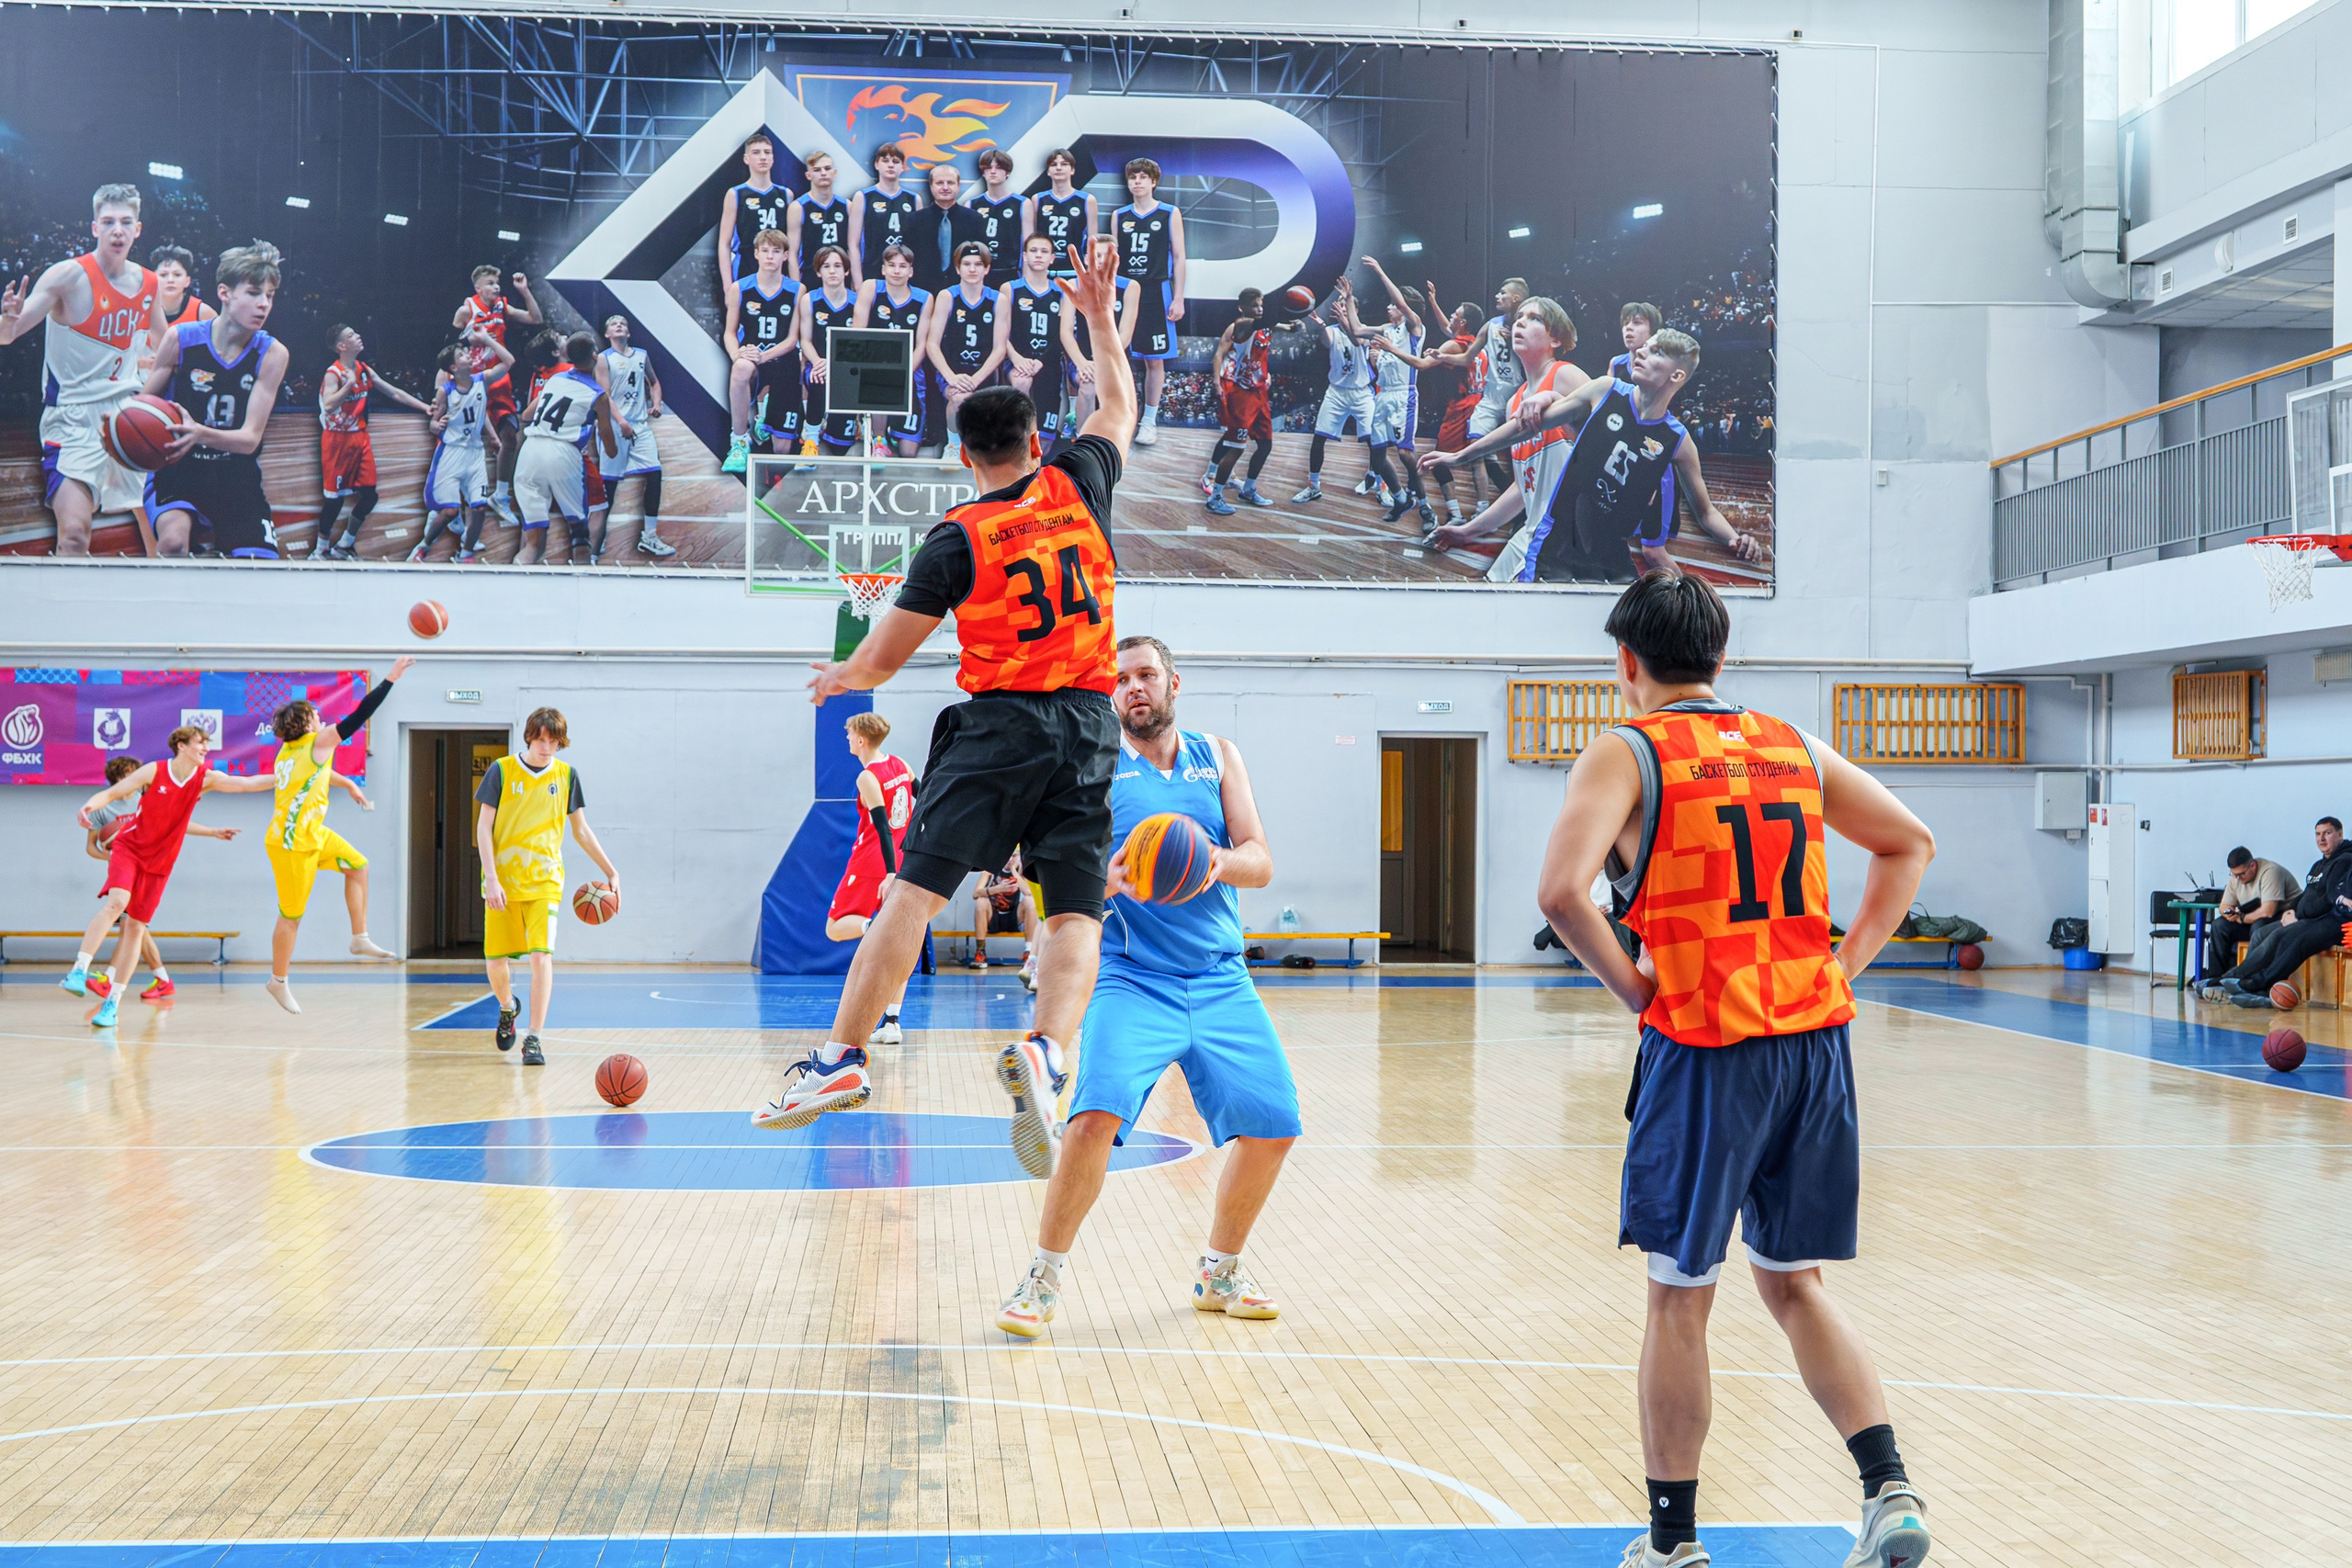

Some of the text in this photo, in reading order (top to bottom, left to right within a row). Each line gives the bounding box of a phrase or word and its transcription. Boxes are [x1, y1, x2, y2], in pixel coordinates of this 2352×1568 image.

[757, 208, 777, 230] 34
[888, 212, 900, 232] 4
[986, 218, 999, 237] 8
[1048, 216, 1069, 236] 22
[821, 222, 838, 244] 23
[1130, 232, 1150, 253] 15
[98, 308, 145, 341] ЦСК
[758, 316, 777, 339] 13
[1030, 311, 1048, 335] 19
[966, 324, 978, 346] 5
[1152, 333, 1166, 351] 15
[108, 356, 123, 380] 2
[628, 370, 637, 387] 4
[783, 412, 798, 429] 13
[903, 413, 918, 432] 11
[1043, 412, 1057, 430] 19
[1237, 428, 1249, 441] 22
[797, 480, 979, 516] АРХСТР
[989, 513, 1075, 546] БАСКЕТБОЛ СТУДЕНТАМ
[1003, 544, 1102, 643] 34
[448, 690, 481, 701] ЫХОД
[1419, 702, 1450, 712] ЫХОД
[1, 752, 42, 764] ФБХК
[1690, 761, 1801, 781] БАСКЕТБОЛ СТУДЕНТАМ
[511, 781, 524, 795] 14
[1715, 802, 1807, 924] 17
